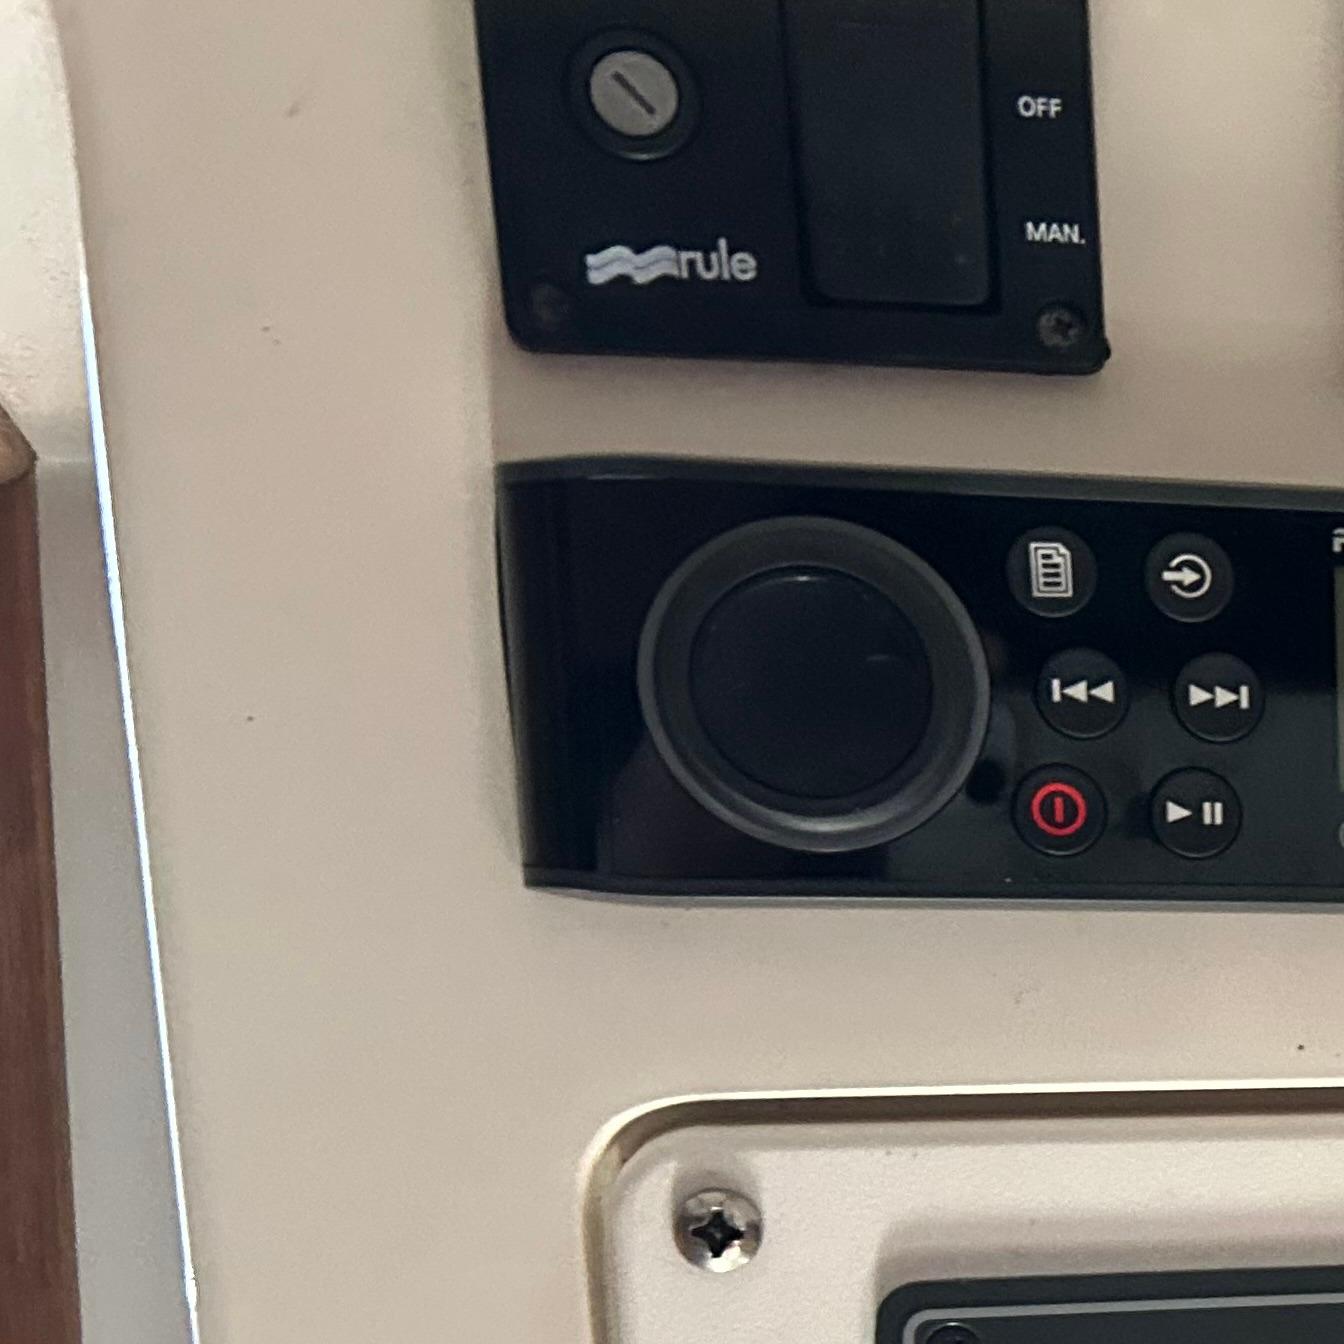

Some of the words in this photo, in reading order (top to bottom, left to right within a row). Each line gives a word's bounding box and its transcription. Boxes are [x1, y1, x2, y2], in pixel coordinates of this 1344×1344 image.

[1018, 96, 1062, 119] OFF
[1026, 221, 1085, 245] MAN.
[678, 237, 757, 282] rule
